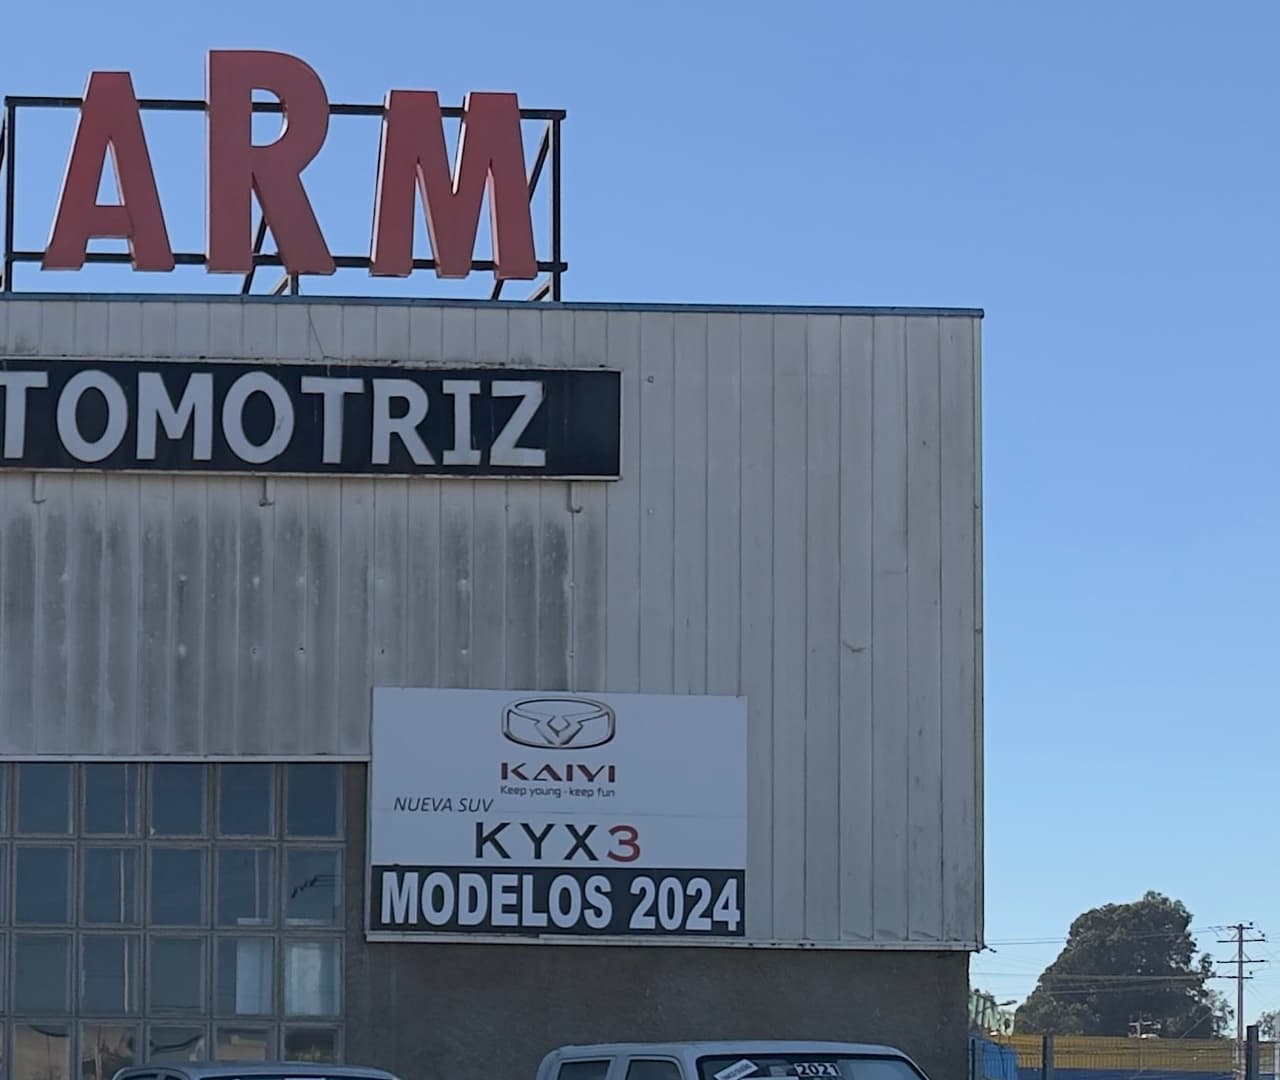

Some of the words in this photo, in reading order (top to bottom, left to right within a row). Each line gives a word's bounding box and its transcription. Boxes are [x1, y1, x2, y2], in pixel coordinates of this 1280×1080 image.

[42, 48, 539, 280] ARM
[500, 761, 616, 784] KAIYI
[500, 785, 527, 798] Keep
[529, 787, 562, 799] young
[568, 785, 594, 798] keep
[596, 786, 616, 798] fun
[393, 797, 453, 813] NUEVA
[457, 797, 494, 813] SUV
[475, 821, 641, 863] KYX3
[380, 870, 614, 930] MODELOS
[629, 876, 741, 932] 2024
[797, 1063, 840, 1076] 2021
